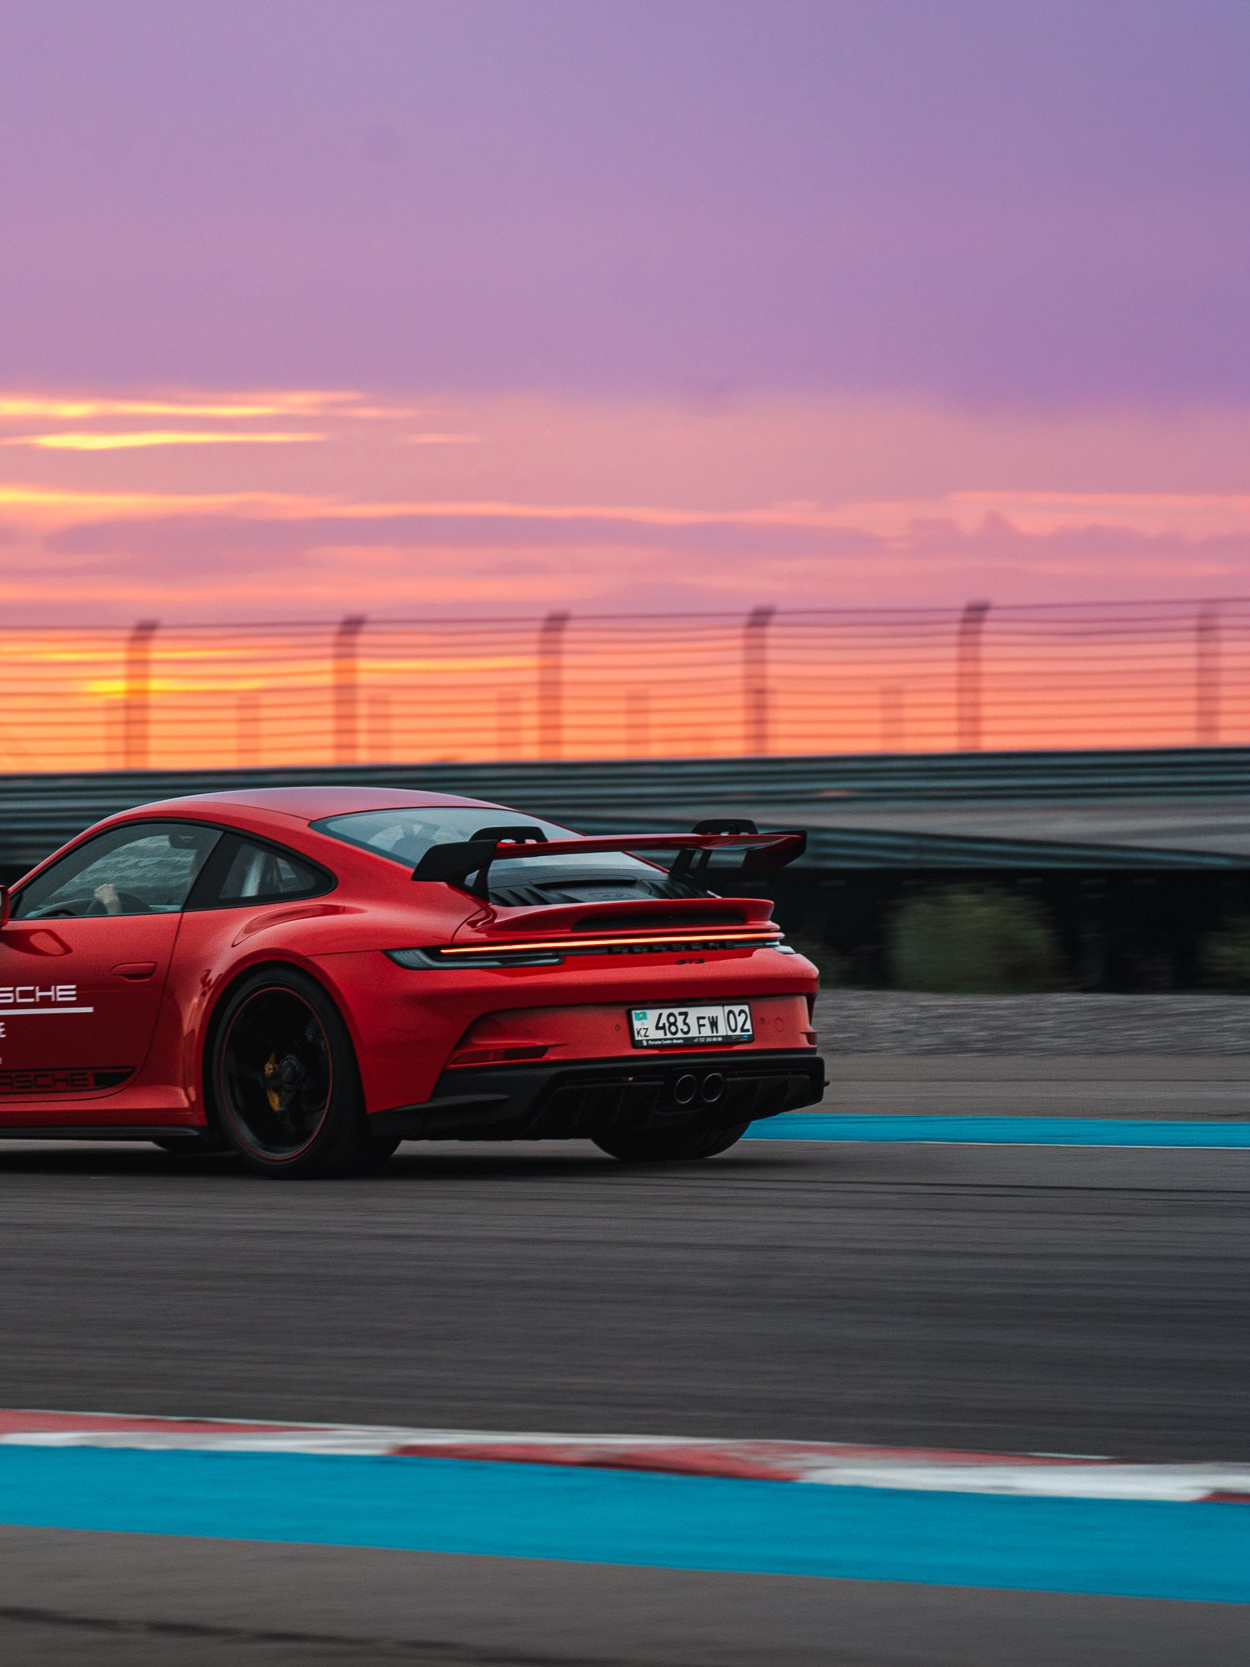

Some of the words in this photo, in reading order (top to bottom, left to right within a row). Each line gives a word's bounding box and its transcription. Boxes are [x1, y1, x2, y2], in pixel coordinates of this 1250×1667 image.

[655, 1011, 691, 1036] 483
[696, 1015, 719, 1034] FW
[726, 1009, 750, 1033] 02
[636, 1027, 649, 1038] KZ
